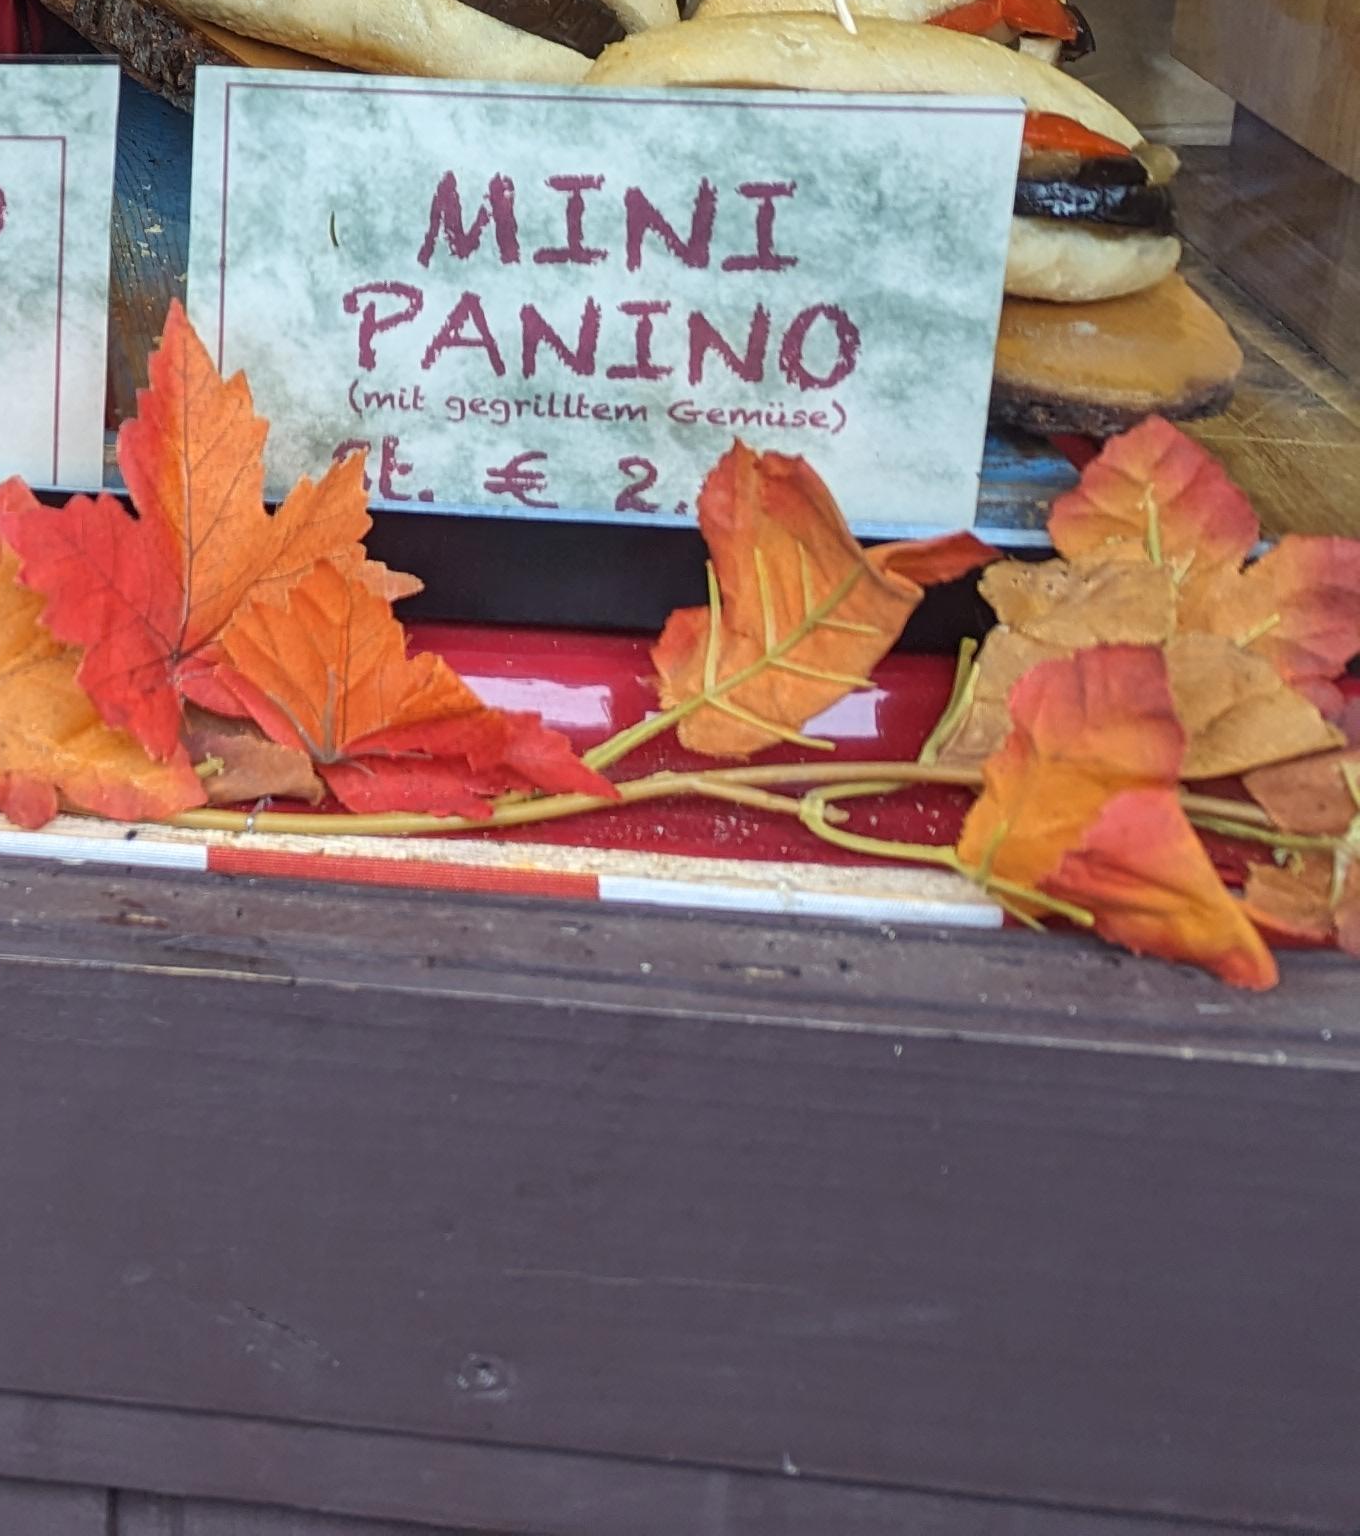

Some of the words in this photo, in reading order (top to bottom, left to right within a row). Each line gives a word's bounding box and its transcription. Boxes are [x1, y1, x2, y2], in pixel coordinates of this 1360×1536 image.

[416, 170, 800, 272] MINI
[342, 280, 862, 390] PANINO
[347, 378, 426, 418] (mit
[444, 391, 649, 425] gegrilltem
[666, 398, 848, 434] Gemüse)
[483, 449, 560, 510] €
